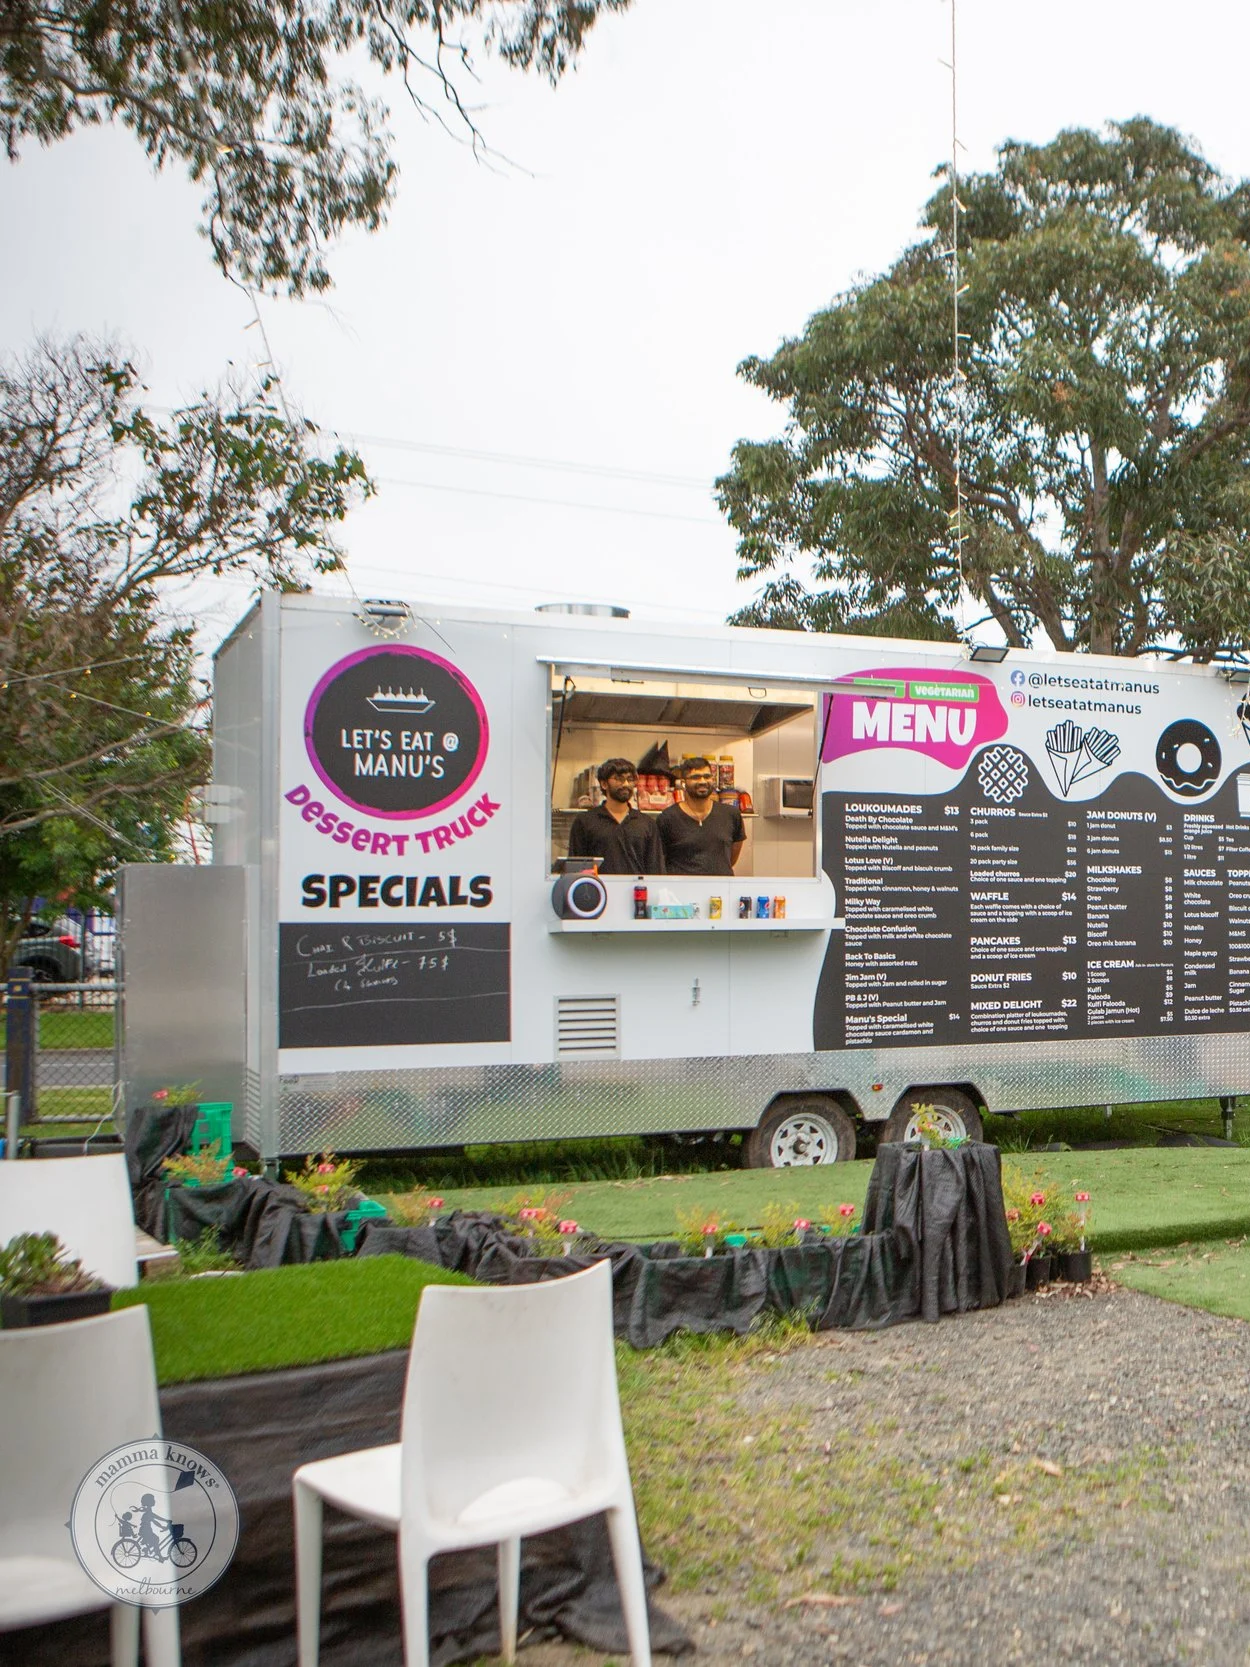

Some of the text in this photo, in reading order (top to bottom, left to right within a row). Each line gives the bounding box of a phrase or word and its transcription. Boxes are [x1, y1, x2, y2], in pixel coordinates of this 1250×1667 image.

[1028, 674, 1160, 695] @letseatatmanus
[1028, 694, 1141, 715] letseatatmanus
[852, 701, 977, 746] MENU
[341, 728, 459, 752] LET'S EAT @
[354, 753, 445, 778] MANU'S
[845, 803, 959, 816] LOUKOUMADES $13
[970, 807, 1016, 817] CHURROS
[845, 815, 867, 823] Death
[868, 816, 877, 824] By
[1086, 811, 1156, 822] JAM DONUTS (V)
[1184, 814, 1215, 822] DRINKS
[415, 792, 501, 854] TRUCK
[872, 836, 898, 844] Delight
[883, 857, 893, 865] (V)
[1087, 866, 1142, 874] MILKSHAKES
[1184, 869, 1216, 877] SAUCES
[301, 874, 493, 909] SPECIALS
[1087, 885, 1119, 893] Strawberry
[845, 898, 864, 906] Milky
[1062, 892, 1077, 902] $14
[970, 935, 1077, 945] PANCAKES $13
[1087, 961, 1101, 969] ICE
[1103, 960, 1134, 968] CREAM
[877, 973, 887, 981] (V)
[971, 971, 1077, 982] DONUT FRIES $10
[971, 999, 1077, 1010] MIXED DELIGHT $22
[846, 1015, 876, 1023] Manu's
[877, 1014, 907, 1024] Special
